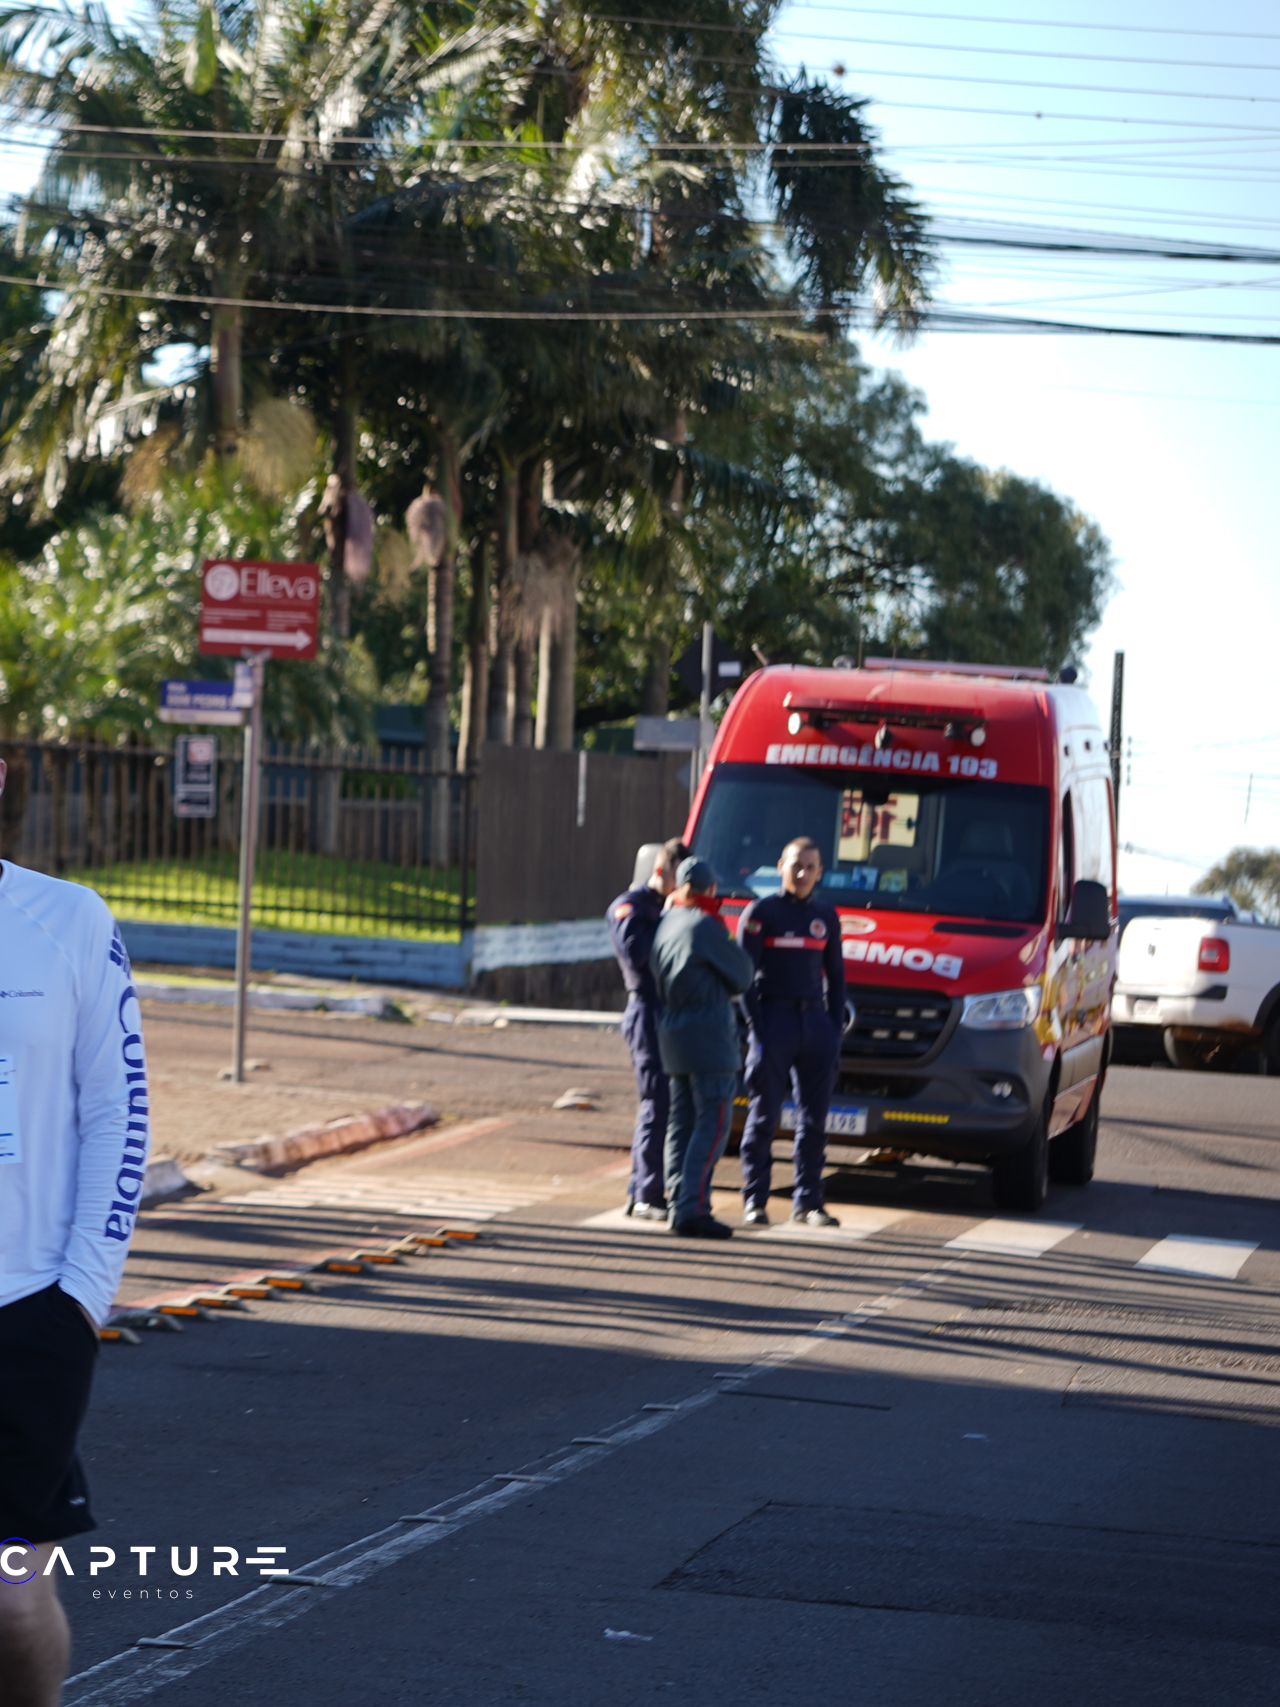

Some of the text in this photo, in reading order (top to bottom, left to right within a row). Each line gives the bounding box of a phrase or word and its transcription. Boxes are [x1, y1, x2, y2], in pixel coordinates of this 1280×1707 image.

[240, 566, 317, 601] Elleva
[765, 743, 997, 779] EMERGÊNCIA 193
[9, 989, 44, 998] Columbia
[105, 985, 149, 1242] Columbia
